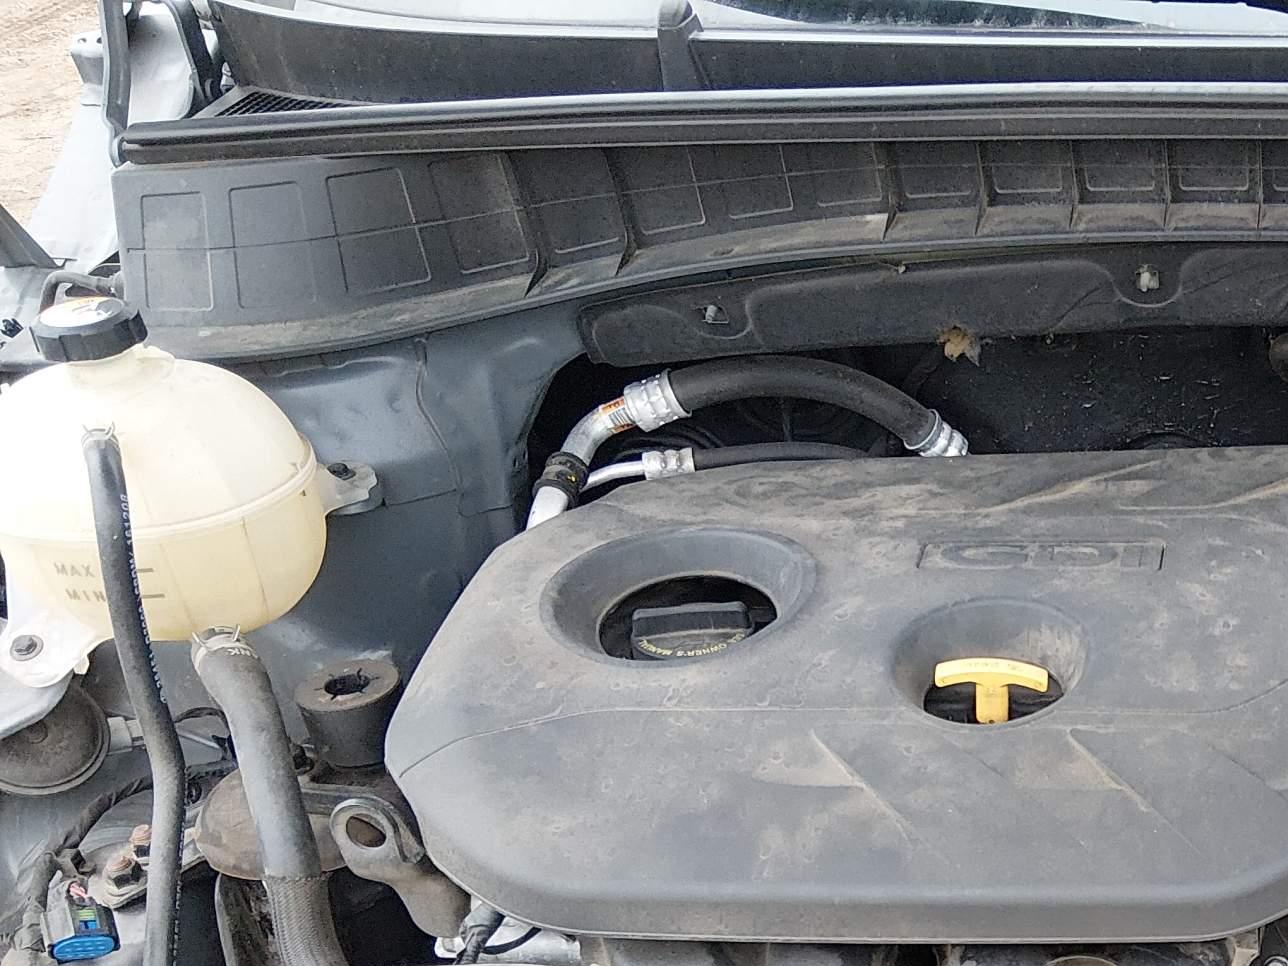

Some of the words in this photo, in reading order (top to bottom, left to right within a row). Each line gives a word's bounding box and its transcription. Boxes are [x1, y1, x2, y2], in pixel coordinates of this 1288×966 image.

[53, 562, 95, 578] MAX
[65, 588, 106, 602] MIN
[676, 642, 728, 657] OWNER'S
